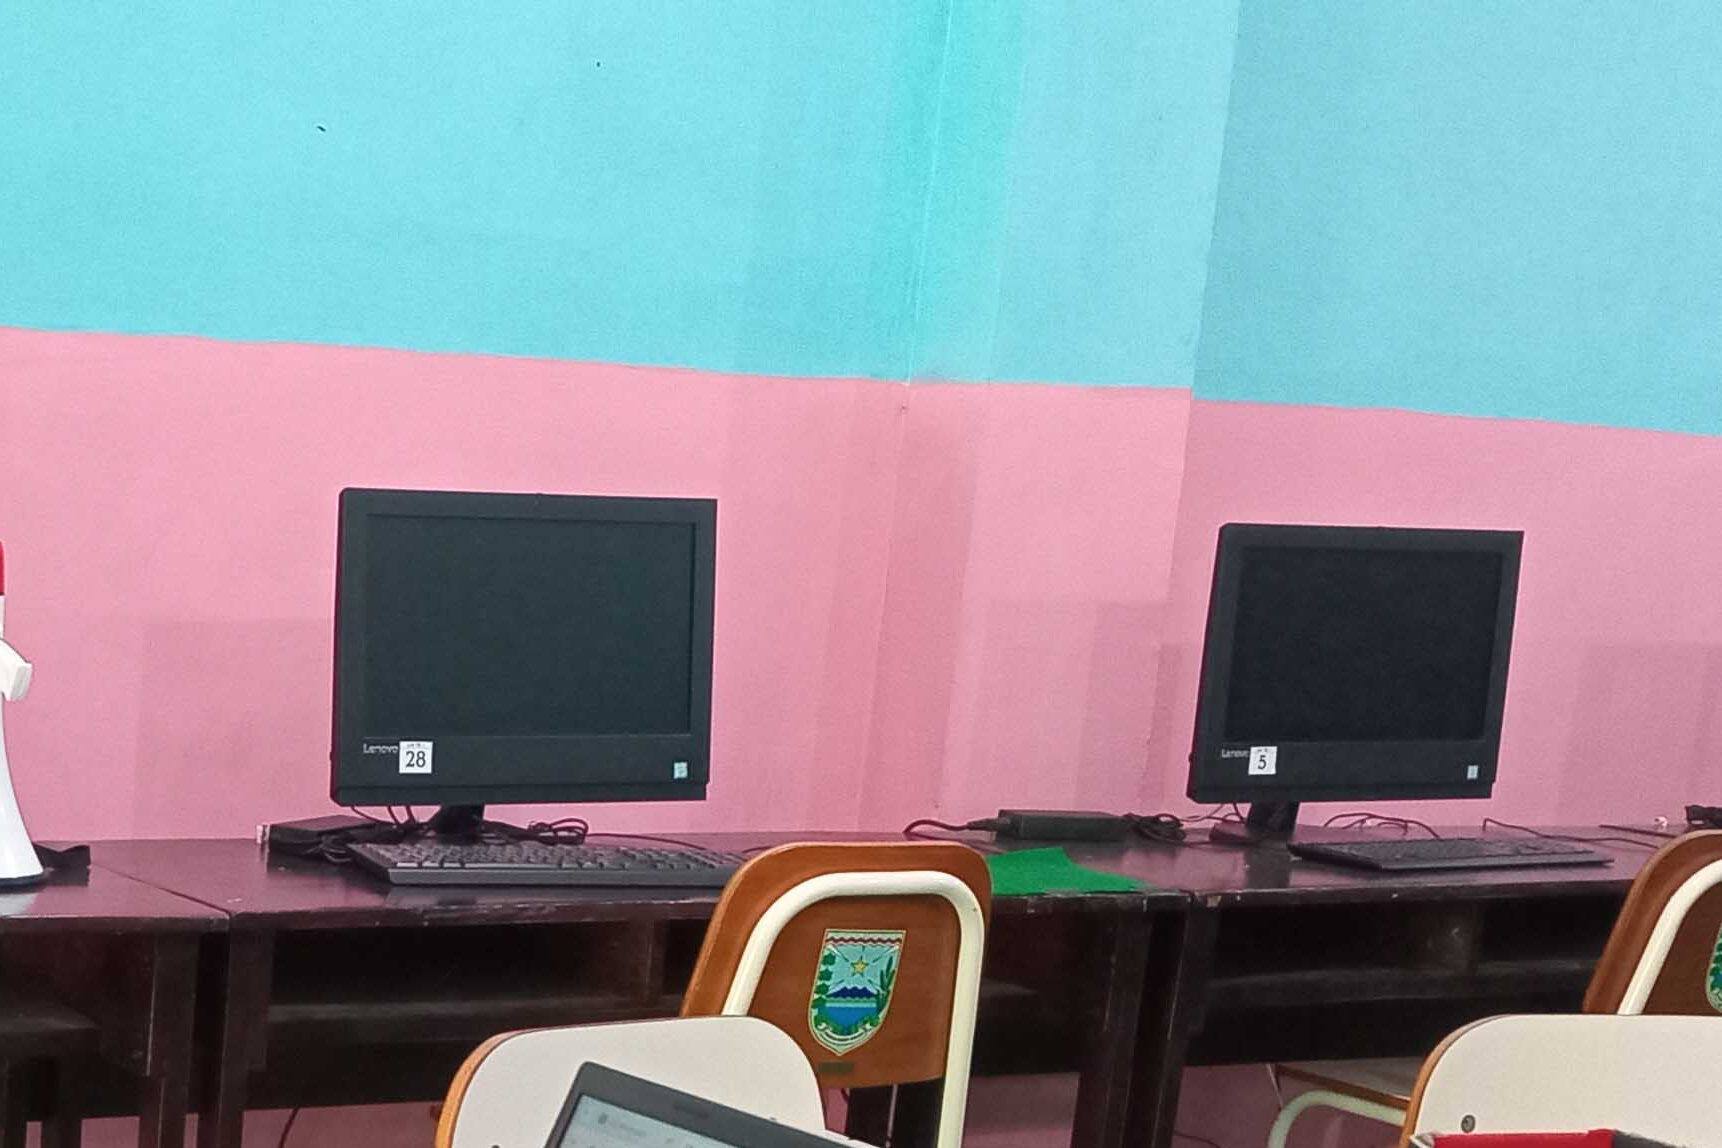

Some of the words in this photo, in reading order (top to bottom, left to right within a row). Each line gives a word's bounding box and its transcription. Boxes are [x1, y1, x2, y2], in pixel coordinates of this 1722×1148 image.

[363, 743, 399, 754] Lenovo
[405, 751, 426, 768] 28
[1258, 755, 1267, 770] 5
